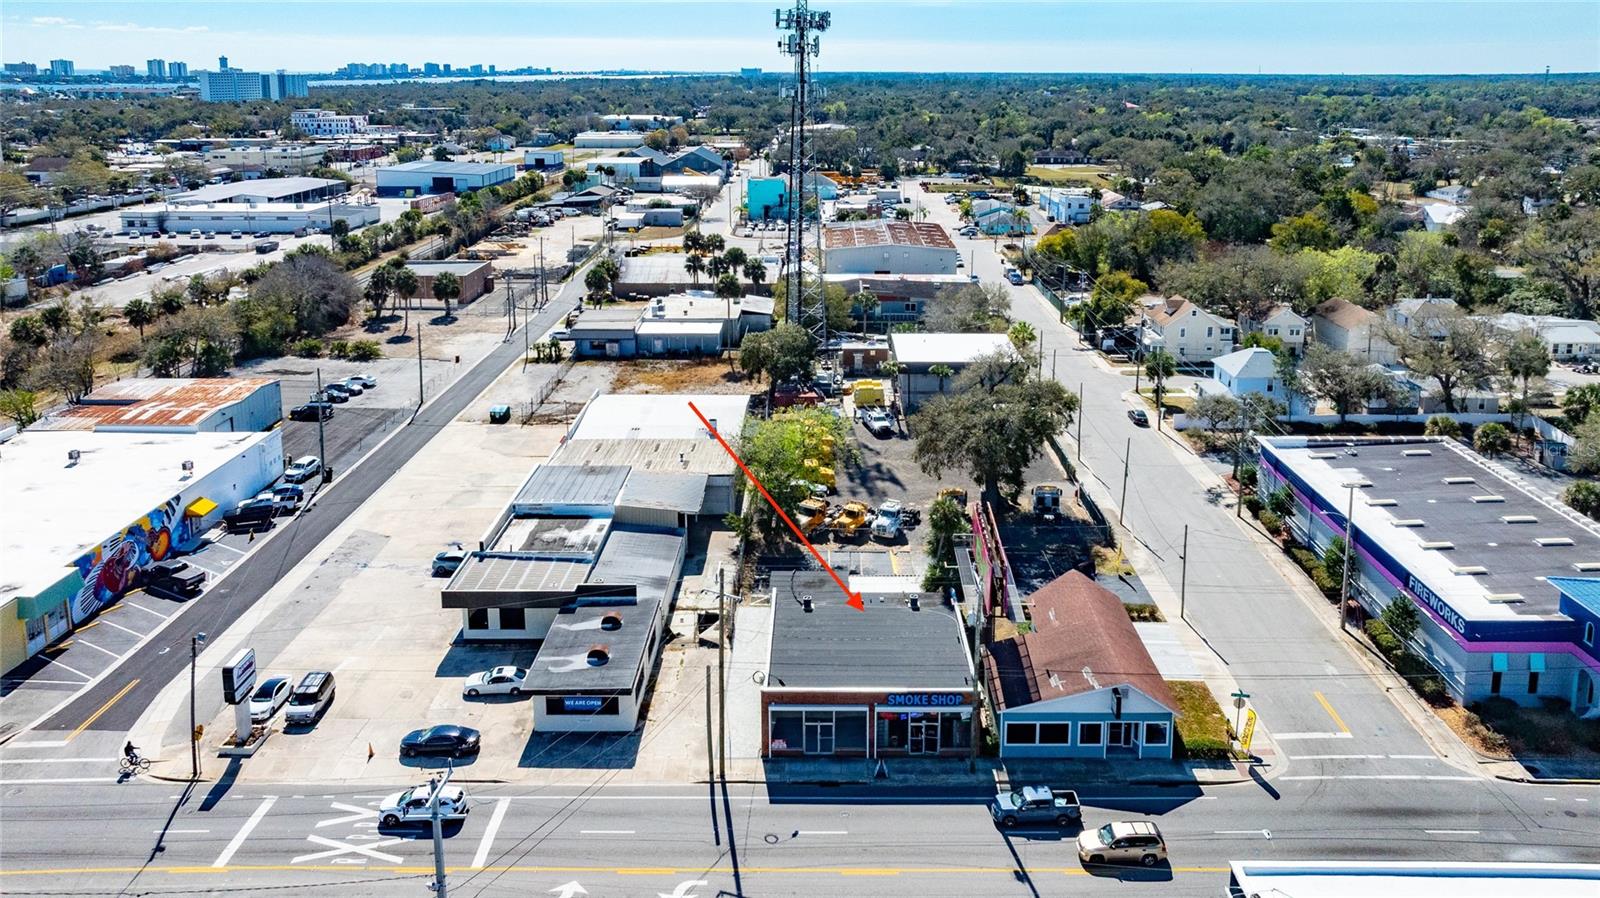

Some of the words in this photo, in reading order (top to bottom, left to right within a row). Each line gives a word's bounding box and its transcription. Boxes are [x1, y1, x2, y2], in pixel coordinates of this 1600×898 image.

[1408, 575, 1466, 634] FIREWORKS
[887, 694, 928, 705] SMOKE
[931, 694, 963, 705] SHOP
